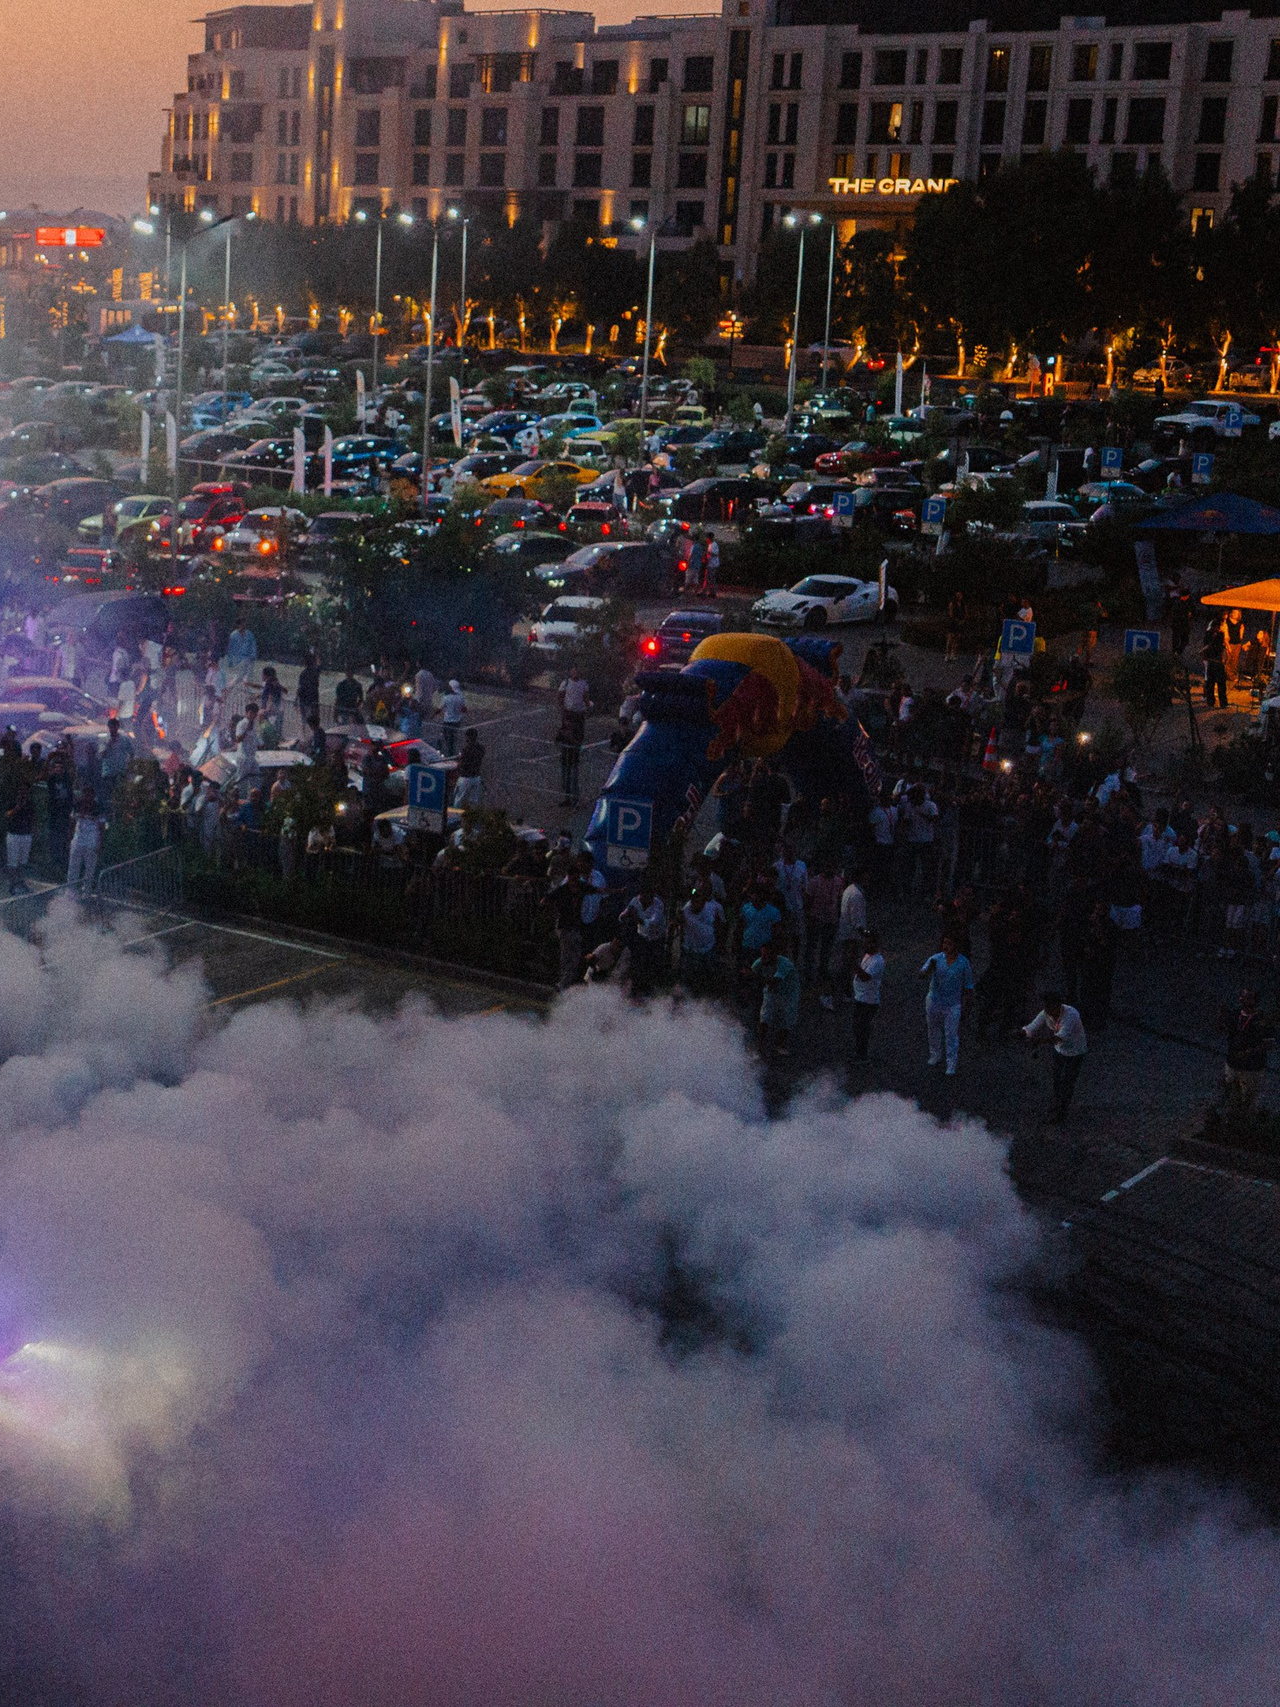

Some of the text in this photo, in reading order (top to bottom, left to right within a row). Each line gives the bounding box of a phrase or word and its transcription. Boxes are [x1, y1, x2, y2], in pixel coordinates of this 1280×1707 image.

[828, 177, 960, 196] THE GRAN
[1230, 413, 1240, 427] P
[1106, 450, 1118, 465] P
[1197, 456, 1209, 471] P
[837, 494, 850, 513] P
[927, 502, 941, 521] P
[1008, 623, 1028, 649] P
[1132, 634, 1151, 654] P
[416, 770, 437, 803] P
[617, 805, 642, 841] P
